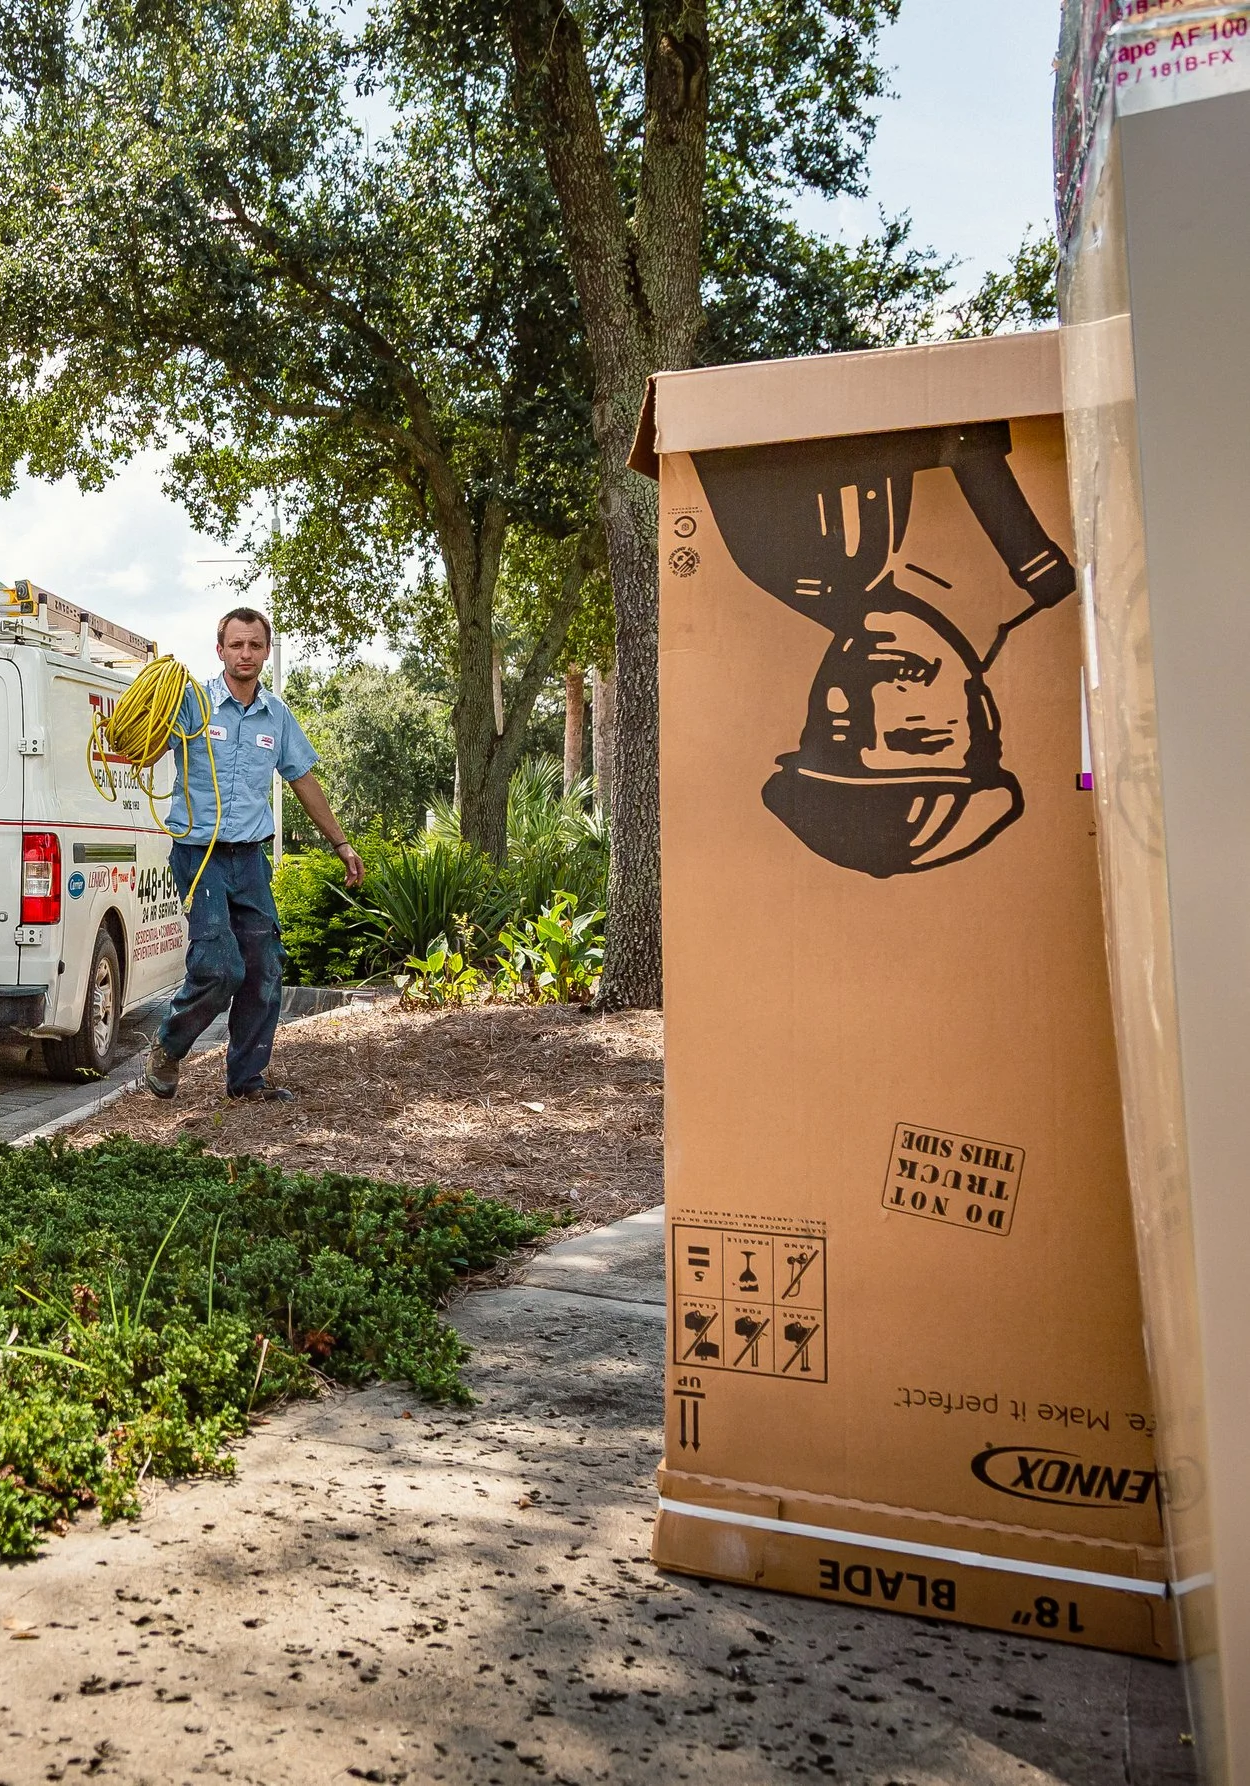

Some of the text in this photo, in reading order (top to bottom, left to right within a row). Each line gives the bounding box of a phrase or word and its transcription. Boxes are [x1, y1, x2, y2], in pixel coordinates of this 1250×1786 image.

[1112, 17, 1247, 64] ape AF 100
[1136, 69, 1141, 83] /
[1151, 49, 1234, 78] 181B-FX
[142, 901, 178, 923] 24 HR SERVICE
[901, 1130, 1015, 1173] THIS SIDE
[896, 1157, 1009, 1201] TRUCK
[890, 1186, 1006, 1229] DO NOT
[703, 1219, 739, 1227] LOCATED
[742, 1222, 792, 1232] PROCEDURE
[727, 1237, 770, 1246] FRAGILE
[784, 1243, 813, 1251] HAND
[683, 1302, 717, 1310] CLAMP
[735, 1307, 762, 1315] FORK
[783, 1312, 816, 1321] SPADE
[678, 1376, 701, 1389] UP
[1011, 1401, 1026, 1422] it
[1037, 1403, 1110, 1431] Make
[1011, 1456, 1157, 1504] ENNOX
[819, 1558, 956, 1612] BLADE
